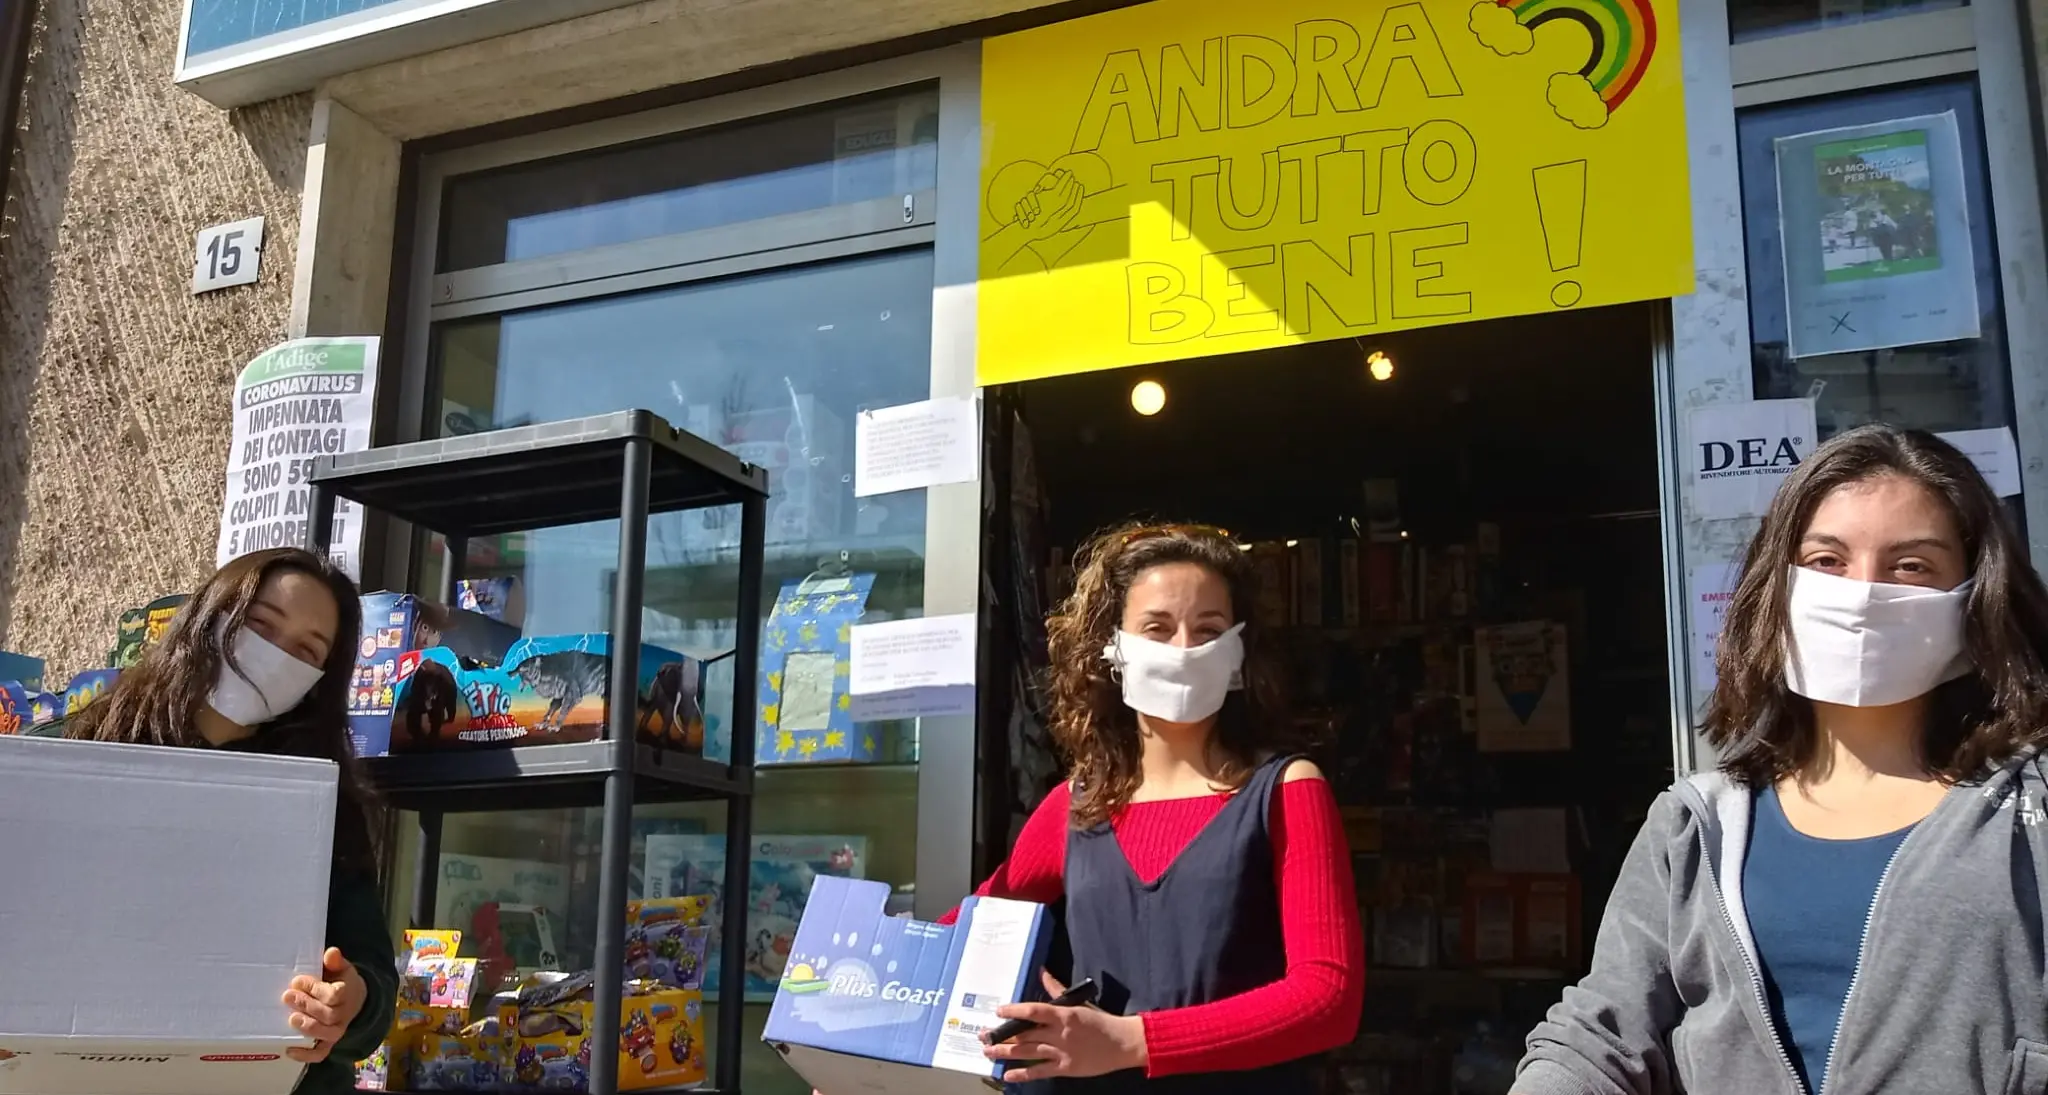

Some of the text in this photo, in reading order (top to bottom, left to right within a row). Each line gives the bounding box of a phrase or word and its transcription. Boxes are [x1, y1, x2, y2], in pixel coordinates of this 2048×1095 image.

[1070, 2, 1463, 154] ANDRA
[1151, 119, 1476, 241] TUTTO
[1827, 166, 1842, 176] LA
[1844, 173, 1866, 183] PER
[207, 230, 244, 279] 15
[1126, 222, 1472, 345] BENE
[244, 375, 356, 406] CORONAVIRUS
[249, 399, 344, 435] IMPENNATA
[242, 428, 347, 466] DEI CONTAGI
[243, 462, 281, 494] SONO
[1700, 470, 1751, 480] RIVENDITORE
[230, 492, 279, 525] COLPITI
[229, 530, 239, 555] 5
[459, 729, 489, 742] CREATURE
[829, 973, 876, 998] Plus
[881, 980, 945, 1007] Coast
